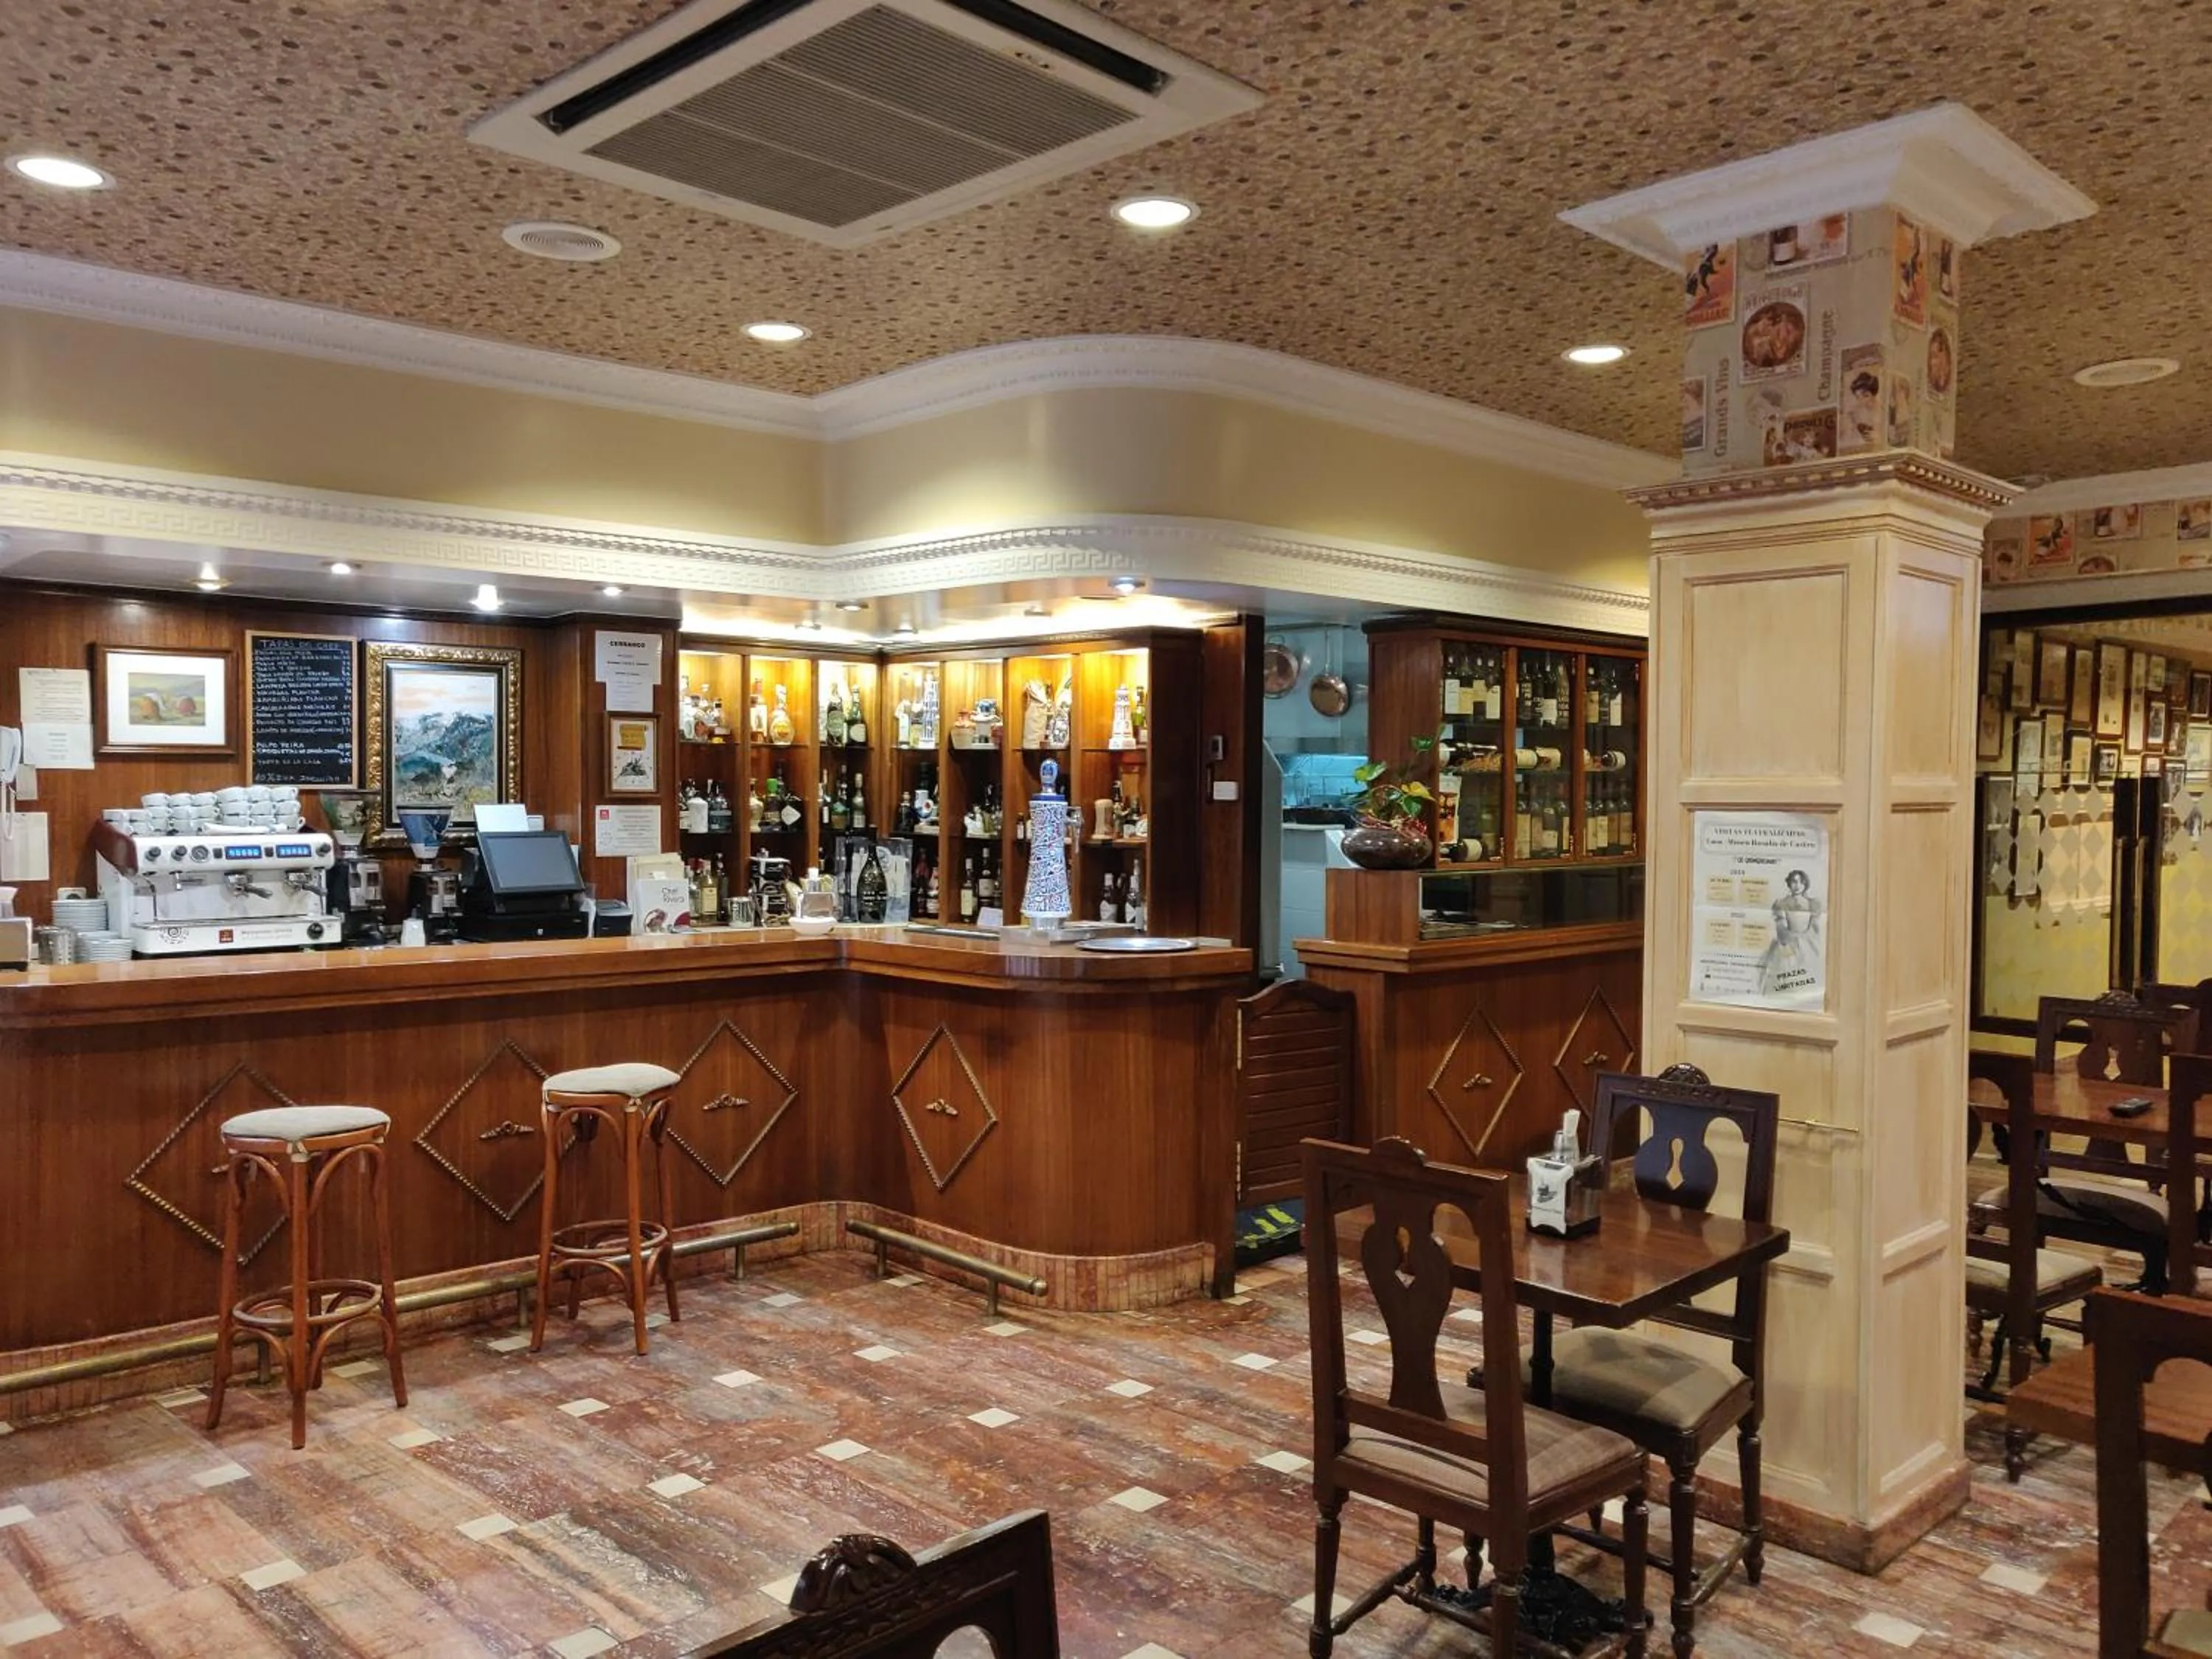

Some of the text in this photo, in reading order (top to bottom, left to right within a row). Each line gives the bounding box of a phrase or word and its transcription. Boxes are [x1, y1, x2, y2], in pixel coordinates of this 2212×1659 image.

[1818, 310, 1835, 401] Champagne
[1714, 358, 1730, 457] Grands Vins
[1773, 977, 1816, 991] LIMITADAS
[1776, 968, 1806, 981] PRAZAS
